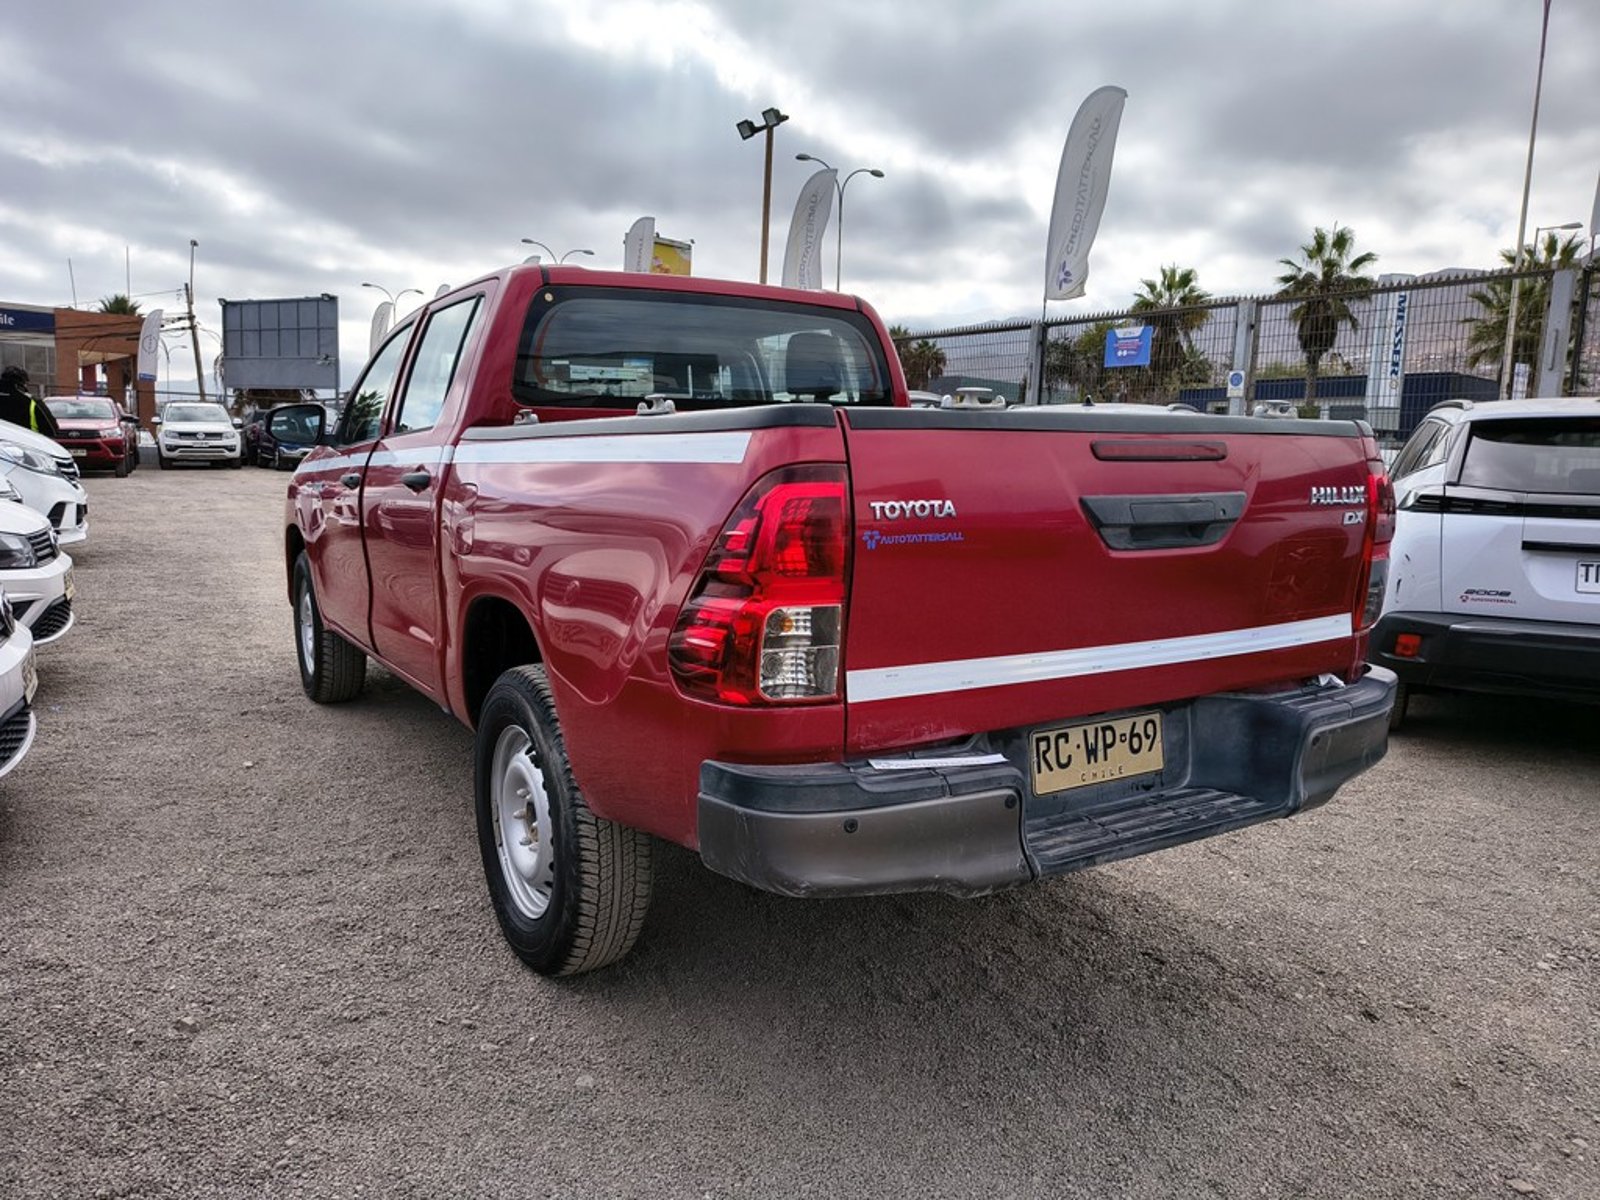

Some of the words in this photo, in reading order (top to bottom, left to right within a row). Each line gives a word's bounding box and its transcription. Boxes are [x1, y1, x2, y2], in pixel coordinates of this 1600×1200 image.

[1390, 294, 1407, 376] MESSER
[1311, 486, 1365, 504] HILUX
[869, 500, 957, 520] TOYOTA
[1343, 511, 1364, 525] DX
[880, 532, 964, 545] AUTOTATTERSALL
[1463, 588, 1512, 597] 2008
[1080, 765, 1124, 782] CHILE
